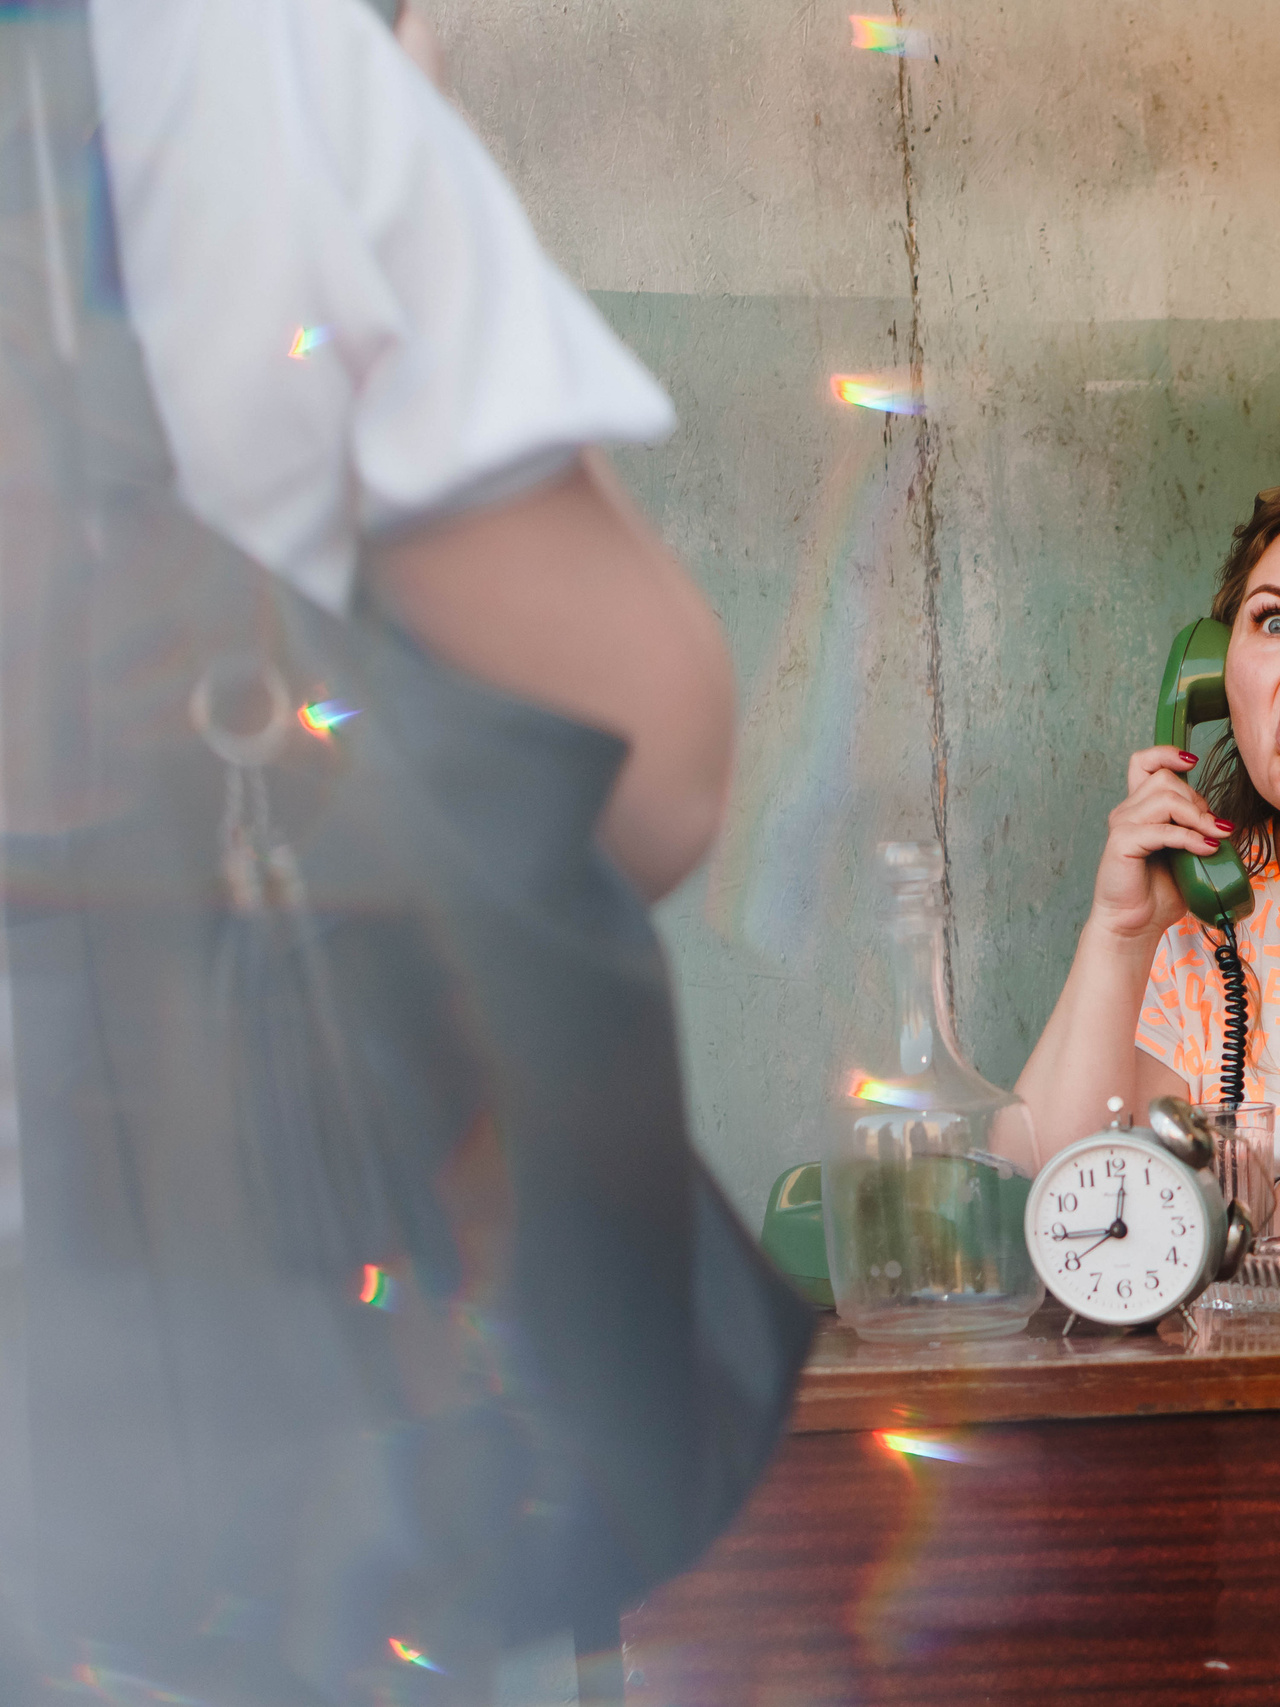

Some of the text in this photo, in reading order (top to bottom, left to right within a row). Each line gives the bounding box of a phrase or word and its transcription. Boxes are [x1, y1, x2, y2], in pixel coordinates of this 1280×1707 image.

[1079, 1168, 1095, 1188] 11
[1105, 1158, 1126, 1178] 12
[1144, 1168, 1150, 1186] 1
[1057, 1194, 1078, 1212] 10
[1160, 1188, 1174, 1208] 2
[1052, 1222, 1067, 1242] 9
[1171, 1217, 1186, 1236] 3
[1065, 1252, 1081, 1271] 8
[1166, 1246, 1180, 1265] 4
[1090, 1272, 1102, 1292] 7
[1116, 1278, 1132, 1298] 6
[1144, 1270, 1160, 1290] 5
